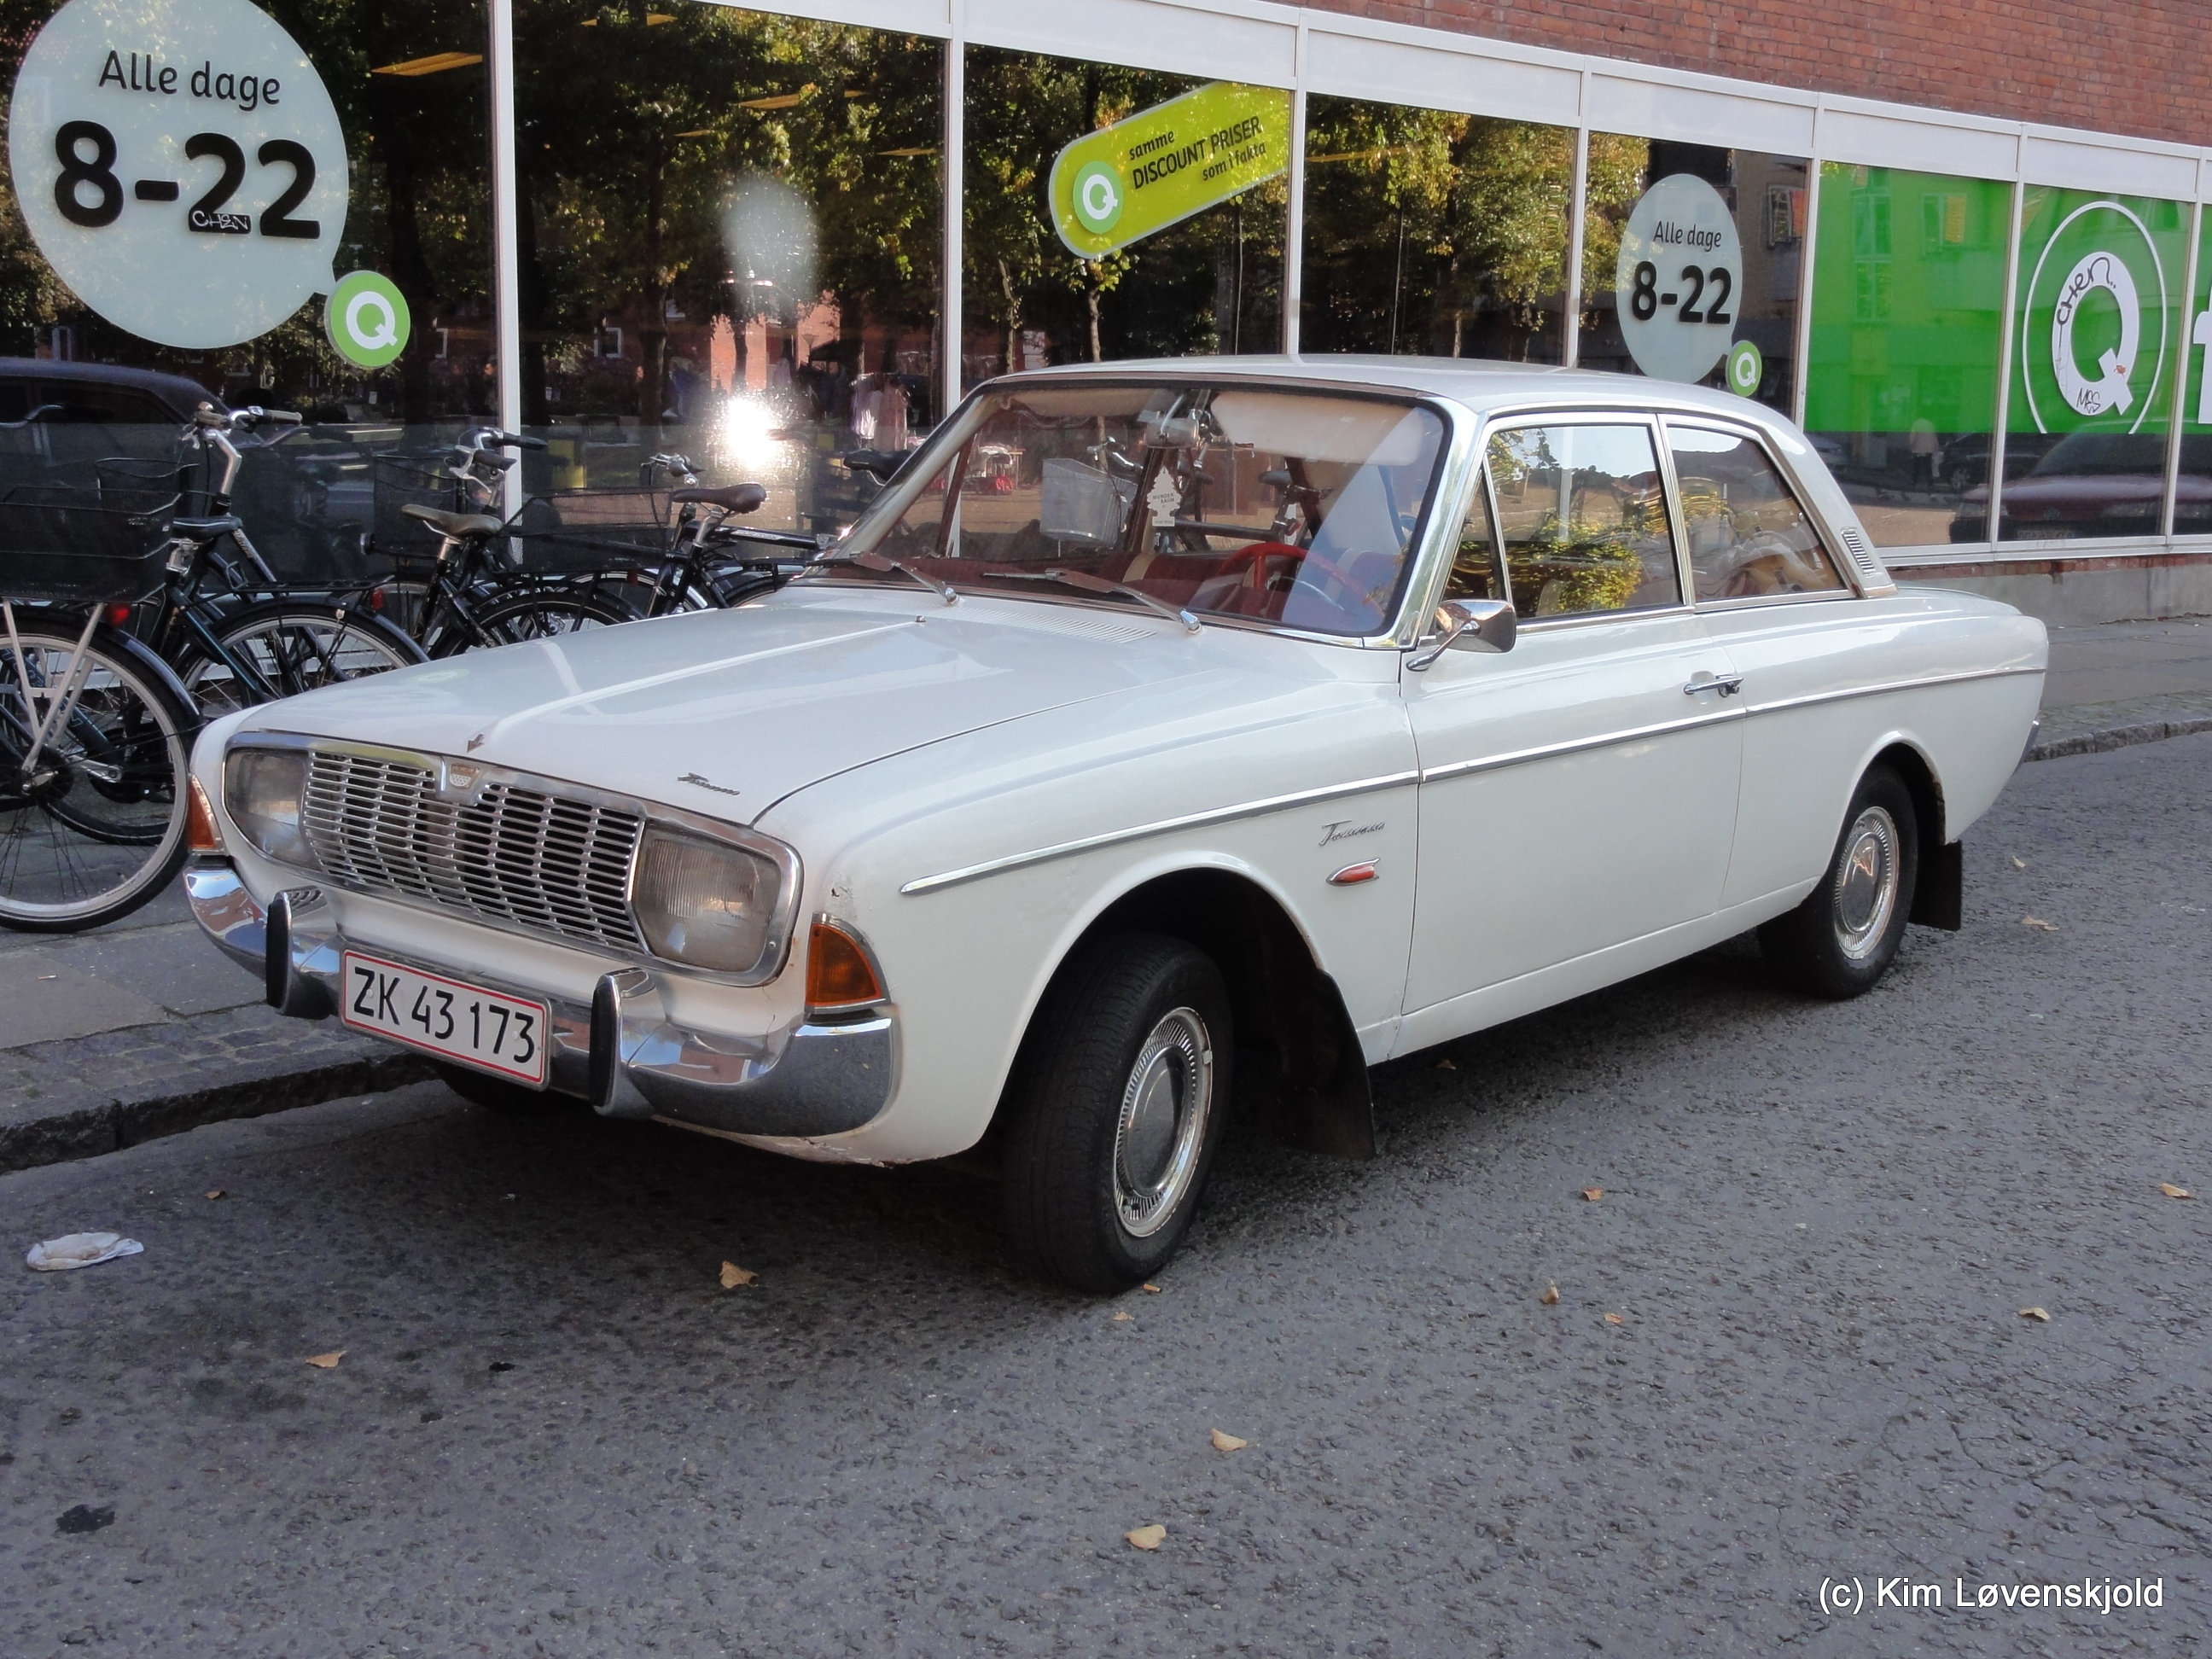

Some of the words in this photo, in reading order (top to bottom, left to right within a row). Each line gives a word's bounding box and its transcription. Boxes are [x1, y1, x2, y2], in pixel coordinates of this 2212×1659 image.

[99, 50, 178, 95] Alle
[190, 61, 280, 111] dage
[1129, 131, 1175, 160] samme
[1132, 138, 1206, 189] DISCOUNT
[1210, 116, 1262, 154] PRISER
[1202, 160, 1227, 181] som
[1234, 143, 1267, 166] fakta
[55, 120, 320, 239] 8-22
[1082, 174, 1118, 220] Q
[1653, 220, 1684, 244] Alle
[1687, 224, 1722, 252] dage
[346, 291, 398, 349] Q
[1632, 260, 1732, 324] 8-22
[2052, 251, 2139, 416] Q
[1736, 352, 1756, 387] Q
[353, 966, 401, 1025] ZK
[411, 986, 454, 1039] 43
[469, 1001, 534, 1063] 173
